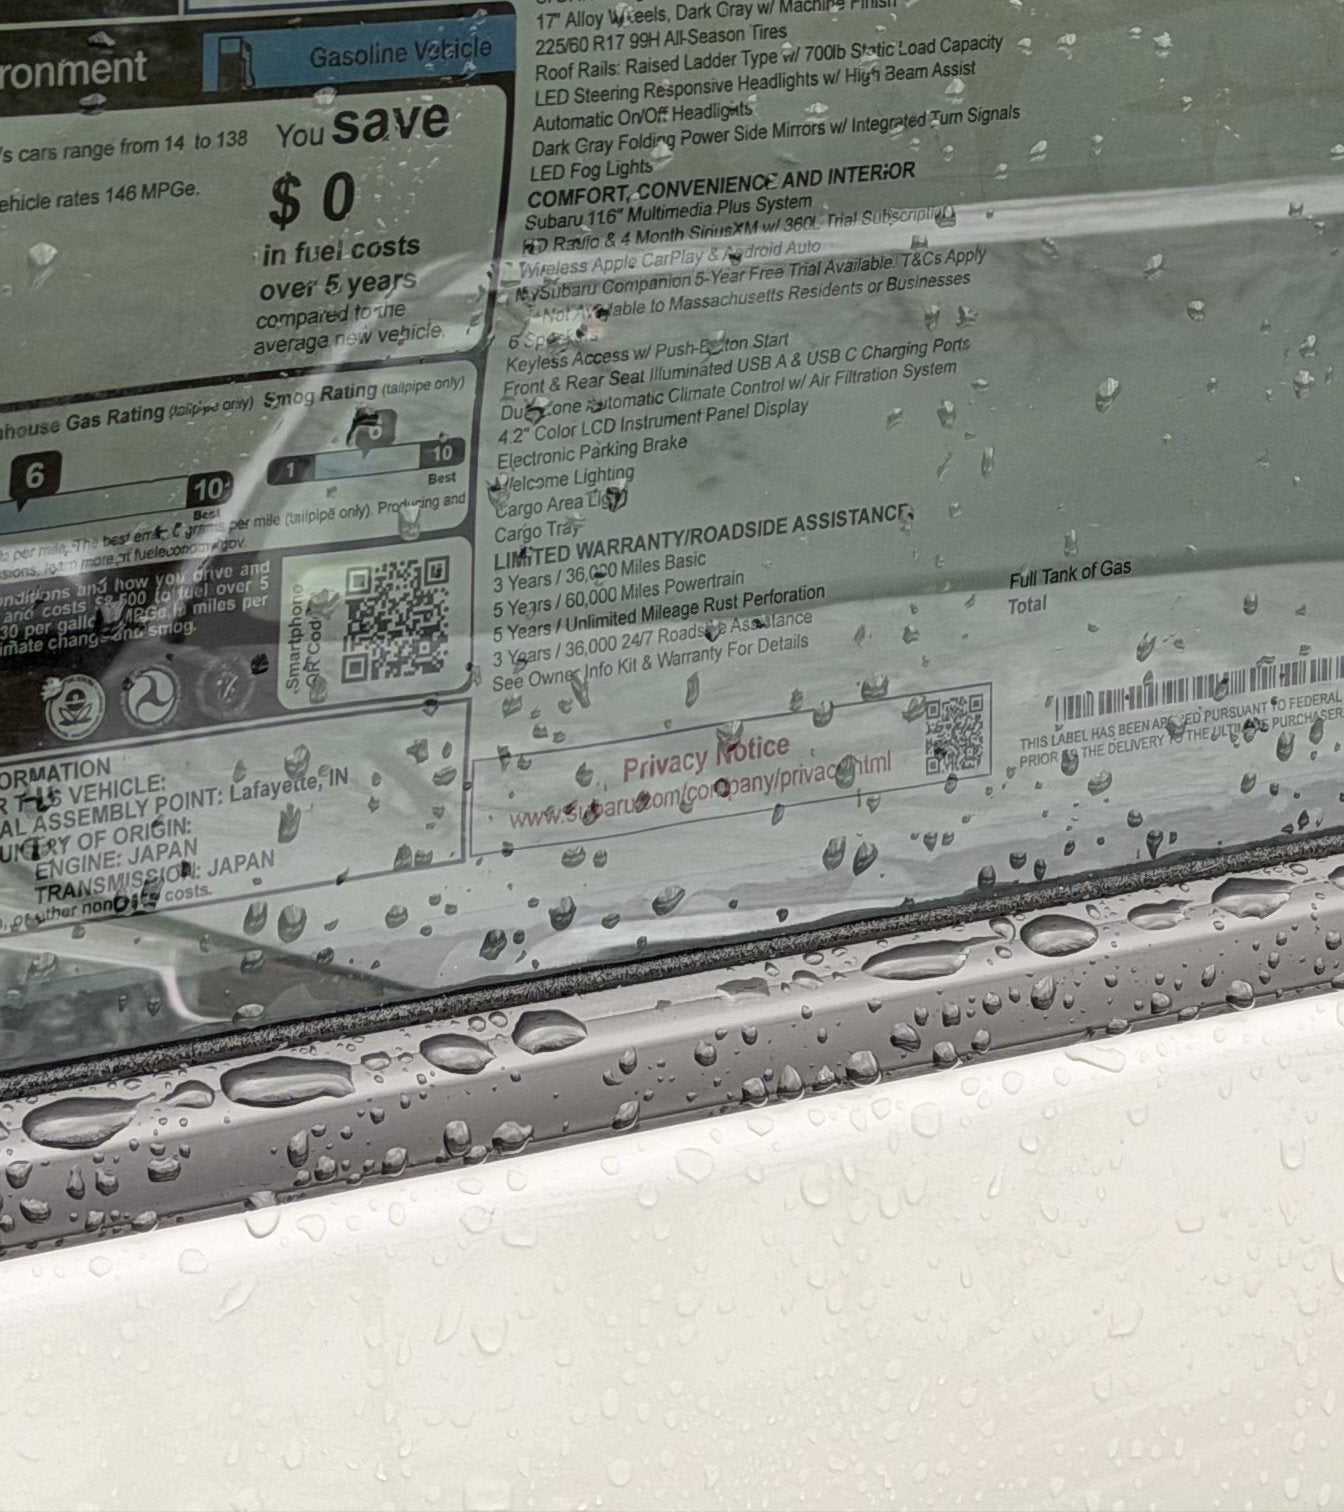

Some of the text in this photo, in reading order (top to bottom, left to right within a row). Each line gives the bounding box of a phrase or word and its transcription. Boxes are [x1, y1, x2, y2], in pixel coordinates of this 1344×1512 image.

[310, 37, 492, 69] Gasoline Vehicle
[276, 103, 451, 149] You save
[17, 144, 58, 162] cars
[62, 140, 116, 161] range
[119, 135, 160, 155] from
[164, 131, 185, 152] 14
[194, 133, 212, 150] to
[216, 127, 248, 148] 138
[55, 189, 100, 208] rates
[105, 182, 137, 204] 146
[140, 178, 200, 201] MPGe.
[635, 171, 779, 201] CONVENIENCE
[780, 168, 823, 190] AND
[827, 161, 916, 187] INTERIOR
[269, 170, 355, 231] $ 0
[262, 237, 421, 266] in fuel costs
[259, 271, 417, 301] over 5 years
[65, 411, 102, 433] Gas
[106, 404, 166, 428] Rating
[497, 399, 809, 446] 4.2" Color LCD Instrument Panel Display
[496, 434, 689, 471] Electronic Parking Brake
[1009, 559, 1136, 590] Full Tank of Gas
[1008, 593, 1048, 617] Total
[622, 750, 710, 783] Privacy
[31, 795, 150, 835] ASSEMBLY
[154, 784, 223, 816] POINT:
[329, 764, 349, 789] IN
